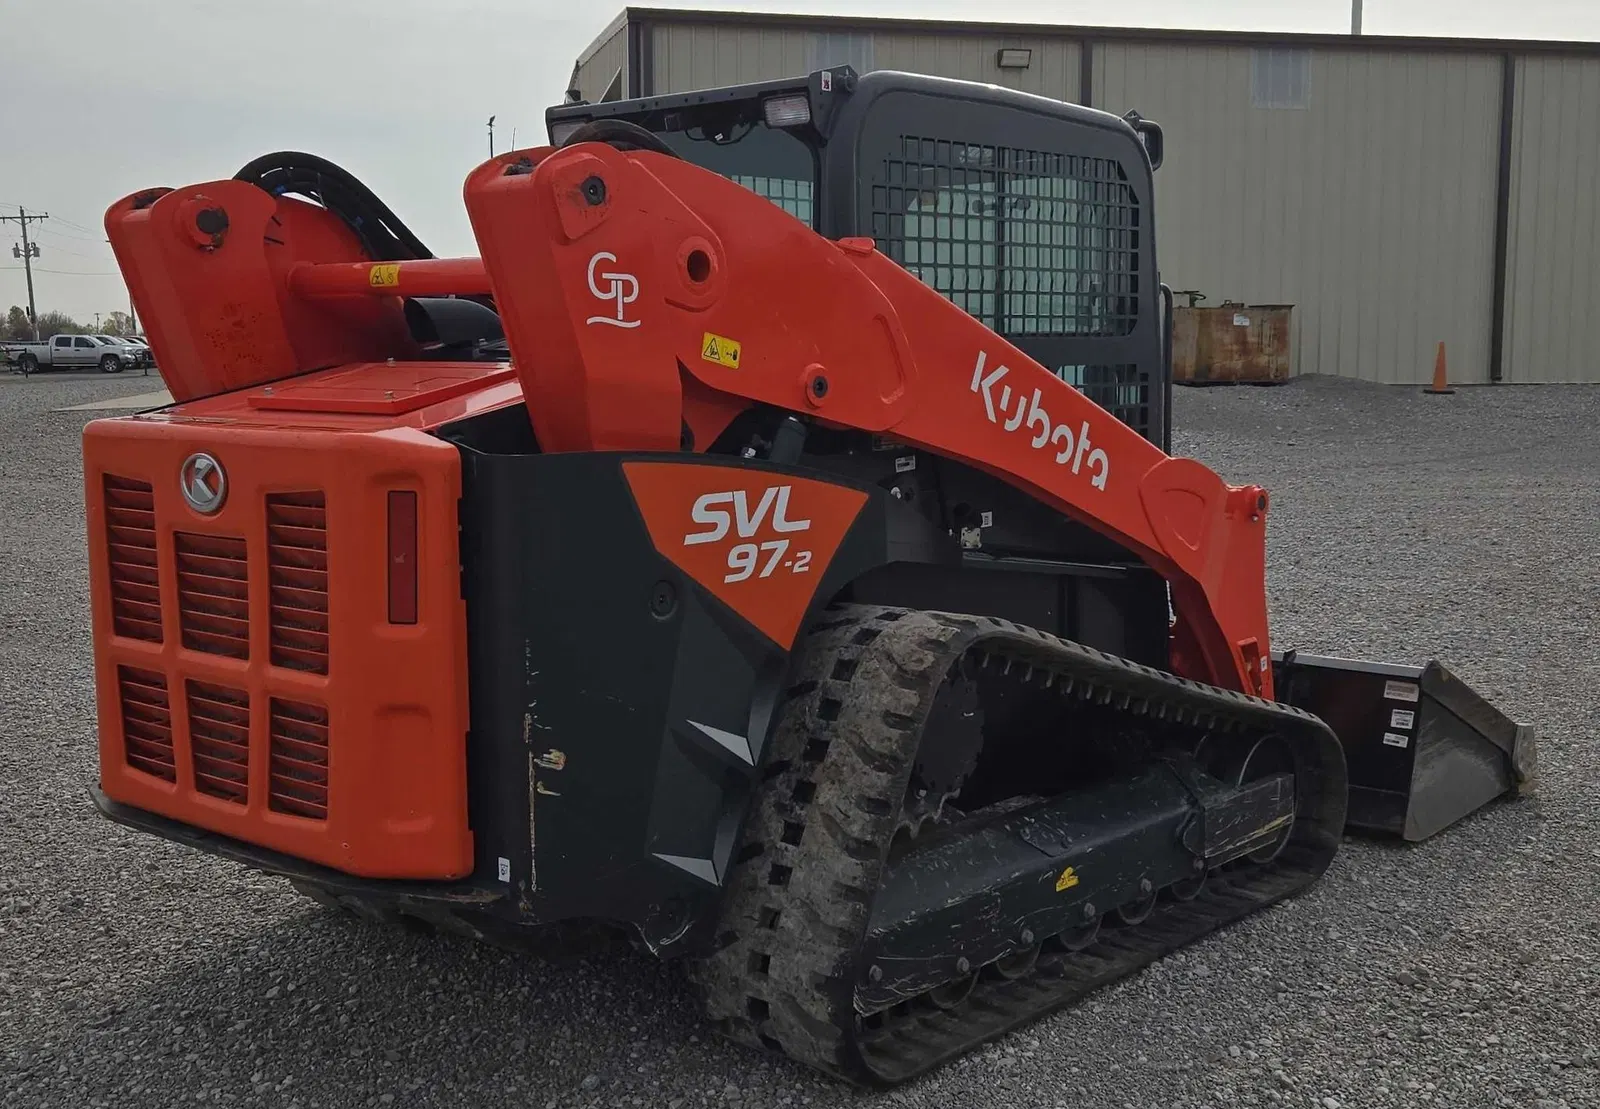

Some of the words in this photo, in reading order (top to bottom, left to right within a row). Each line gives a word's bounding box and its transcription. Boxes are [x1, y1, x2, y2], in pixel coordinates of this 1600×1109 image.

[970, 350, 1109, 491] Kubota
[684, 486, 811, 546] SVL
[724, 539, 812, 584] 97-2
